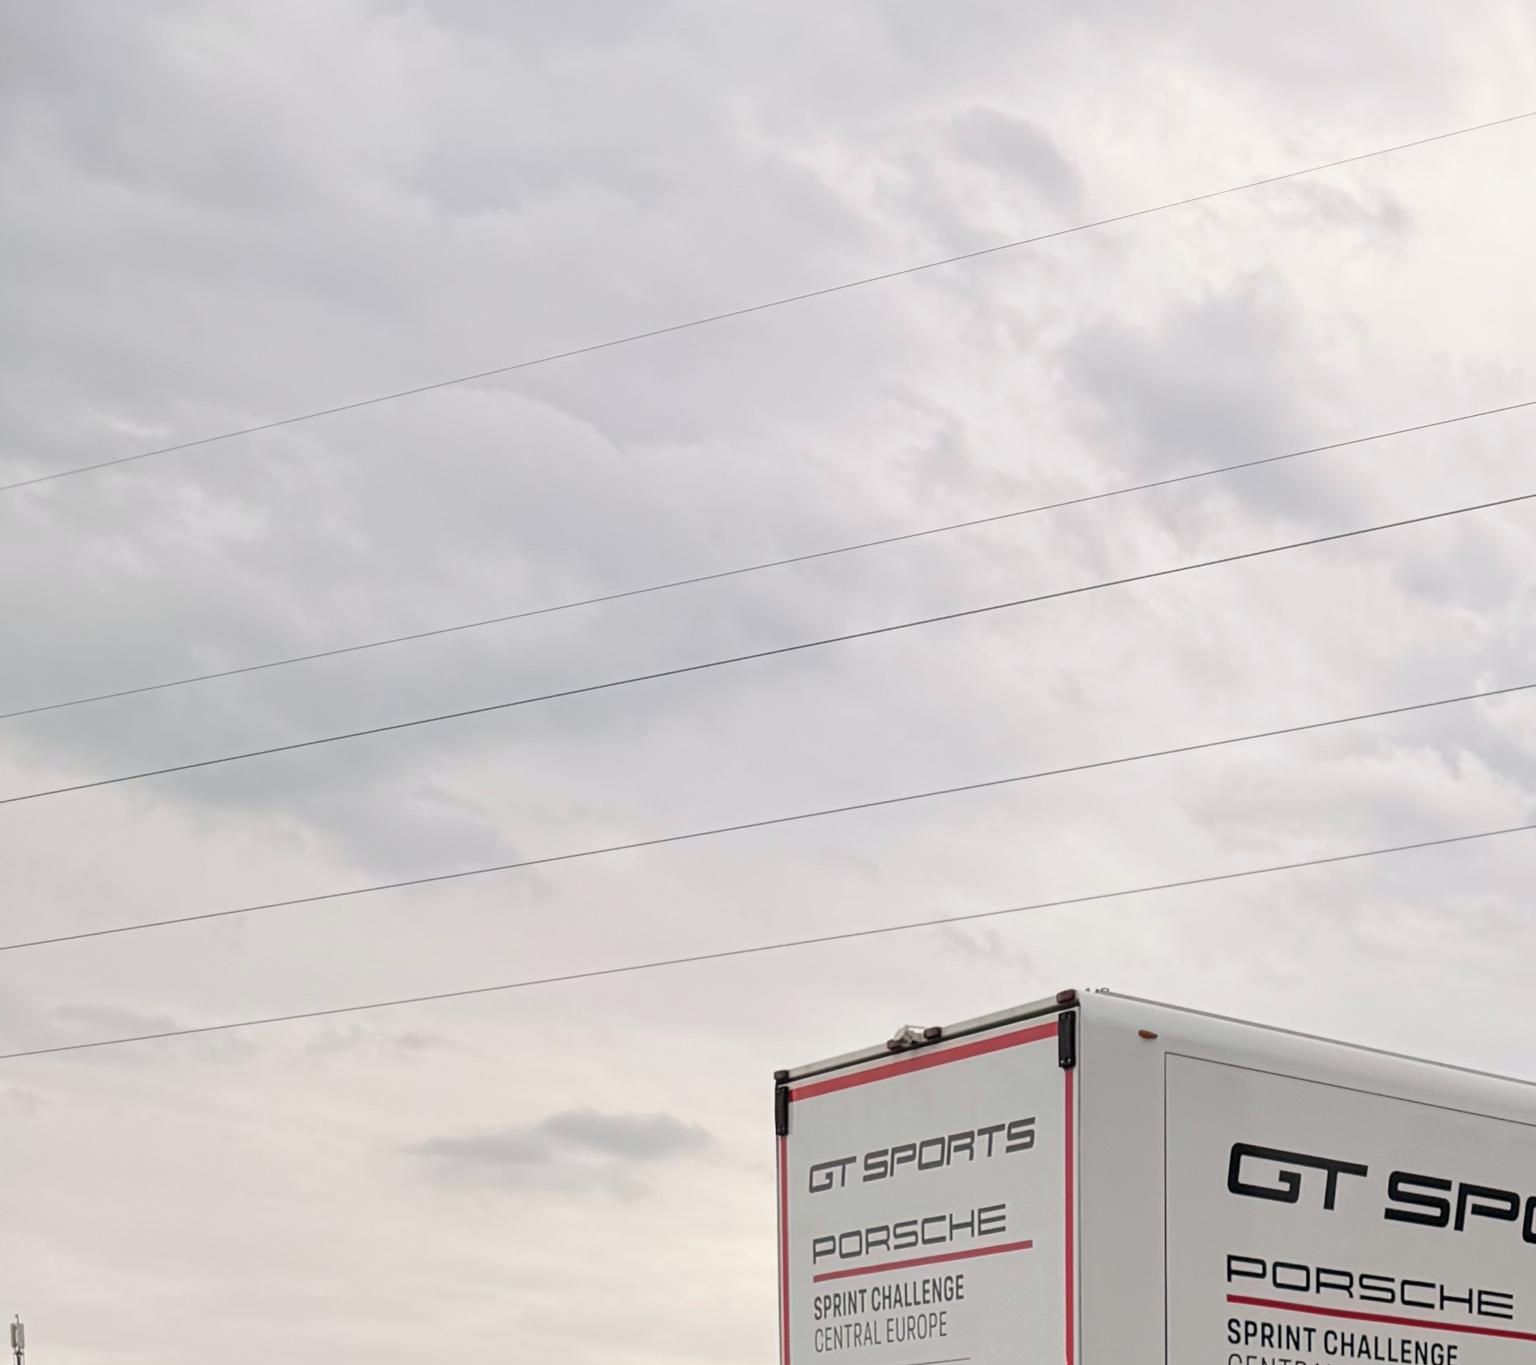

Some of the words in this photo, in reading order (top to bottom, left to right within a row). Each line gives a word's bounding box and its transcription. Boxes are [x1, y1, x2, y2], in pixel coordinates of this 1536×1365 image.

[809, 1156, 857, 1193] GT
[862, 1117, 1036, 1182] SPORTS
[1227, 1142, 1368, 1210] GT
[812, 1203, 1006, 1265] PORSCHE
[814, 1289, 867, 1320] SPRINT
[871, 1274, 965, 1312] CHALLENGE
[1227, 1254, 1514, 1320] PORSCHE
[815, 1320, 881, 1353] CENTRAL
[887, 1311, 948, 1343] EUROPE
[1227, 1318, 1316, 1353] SPRINT
